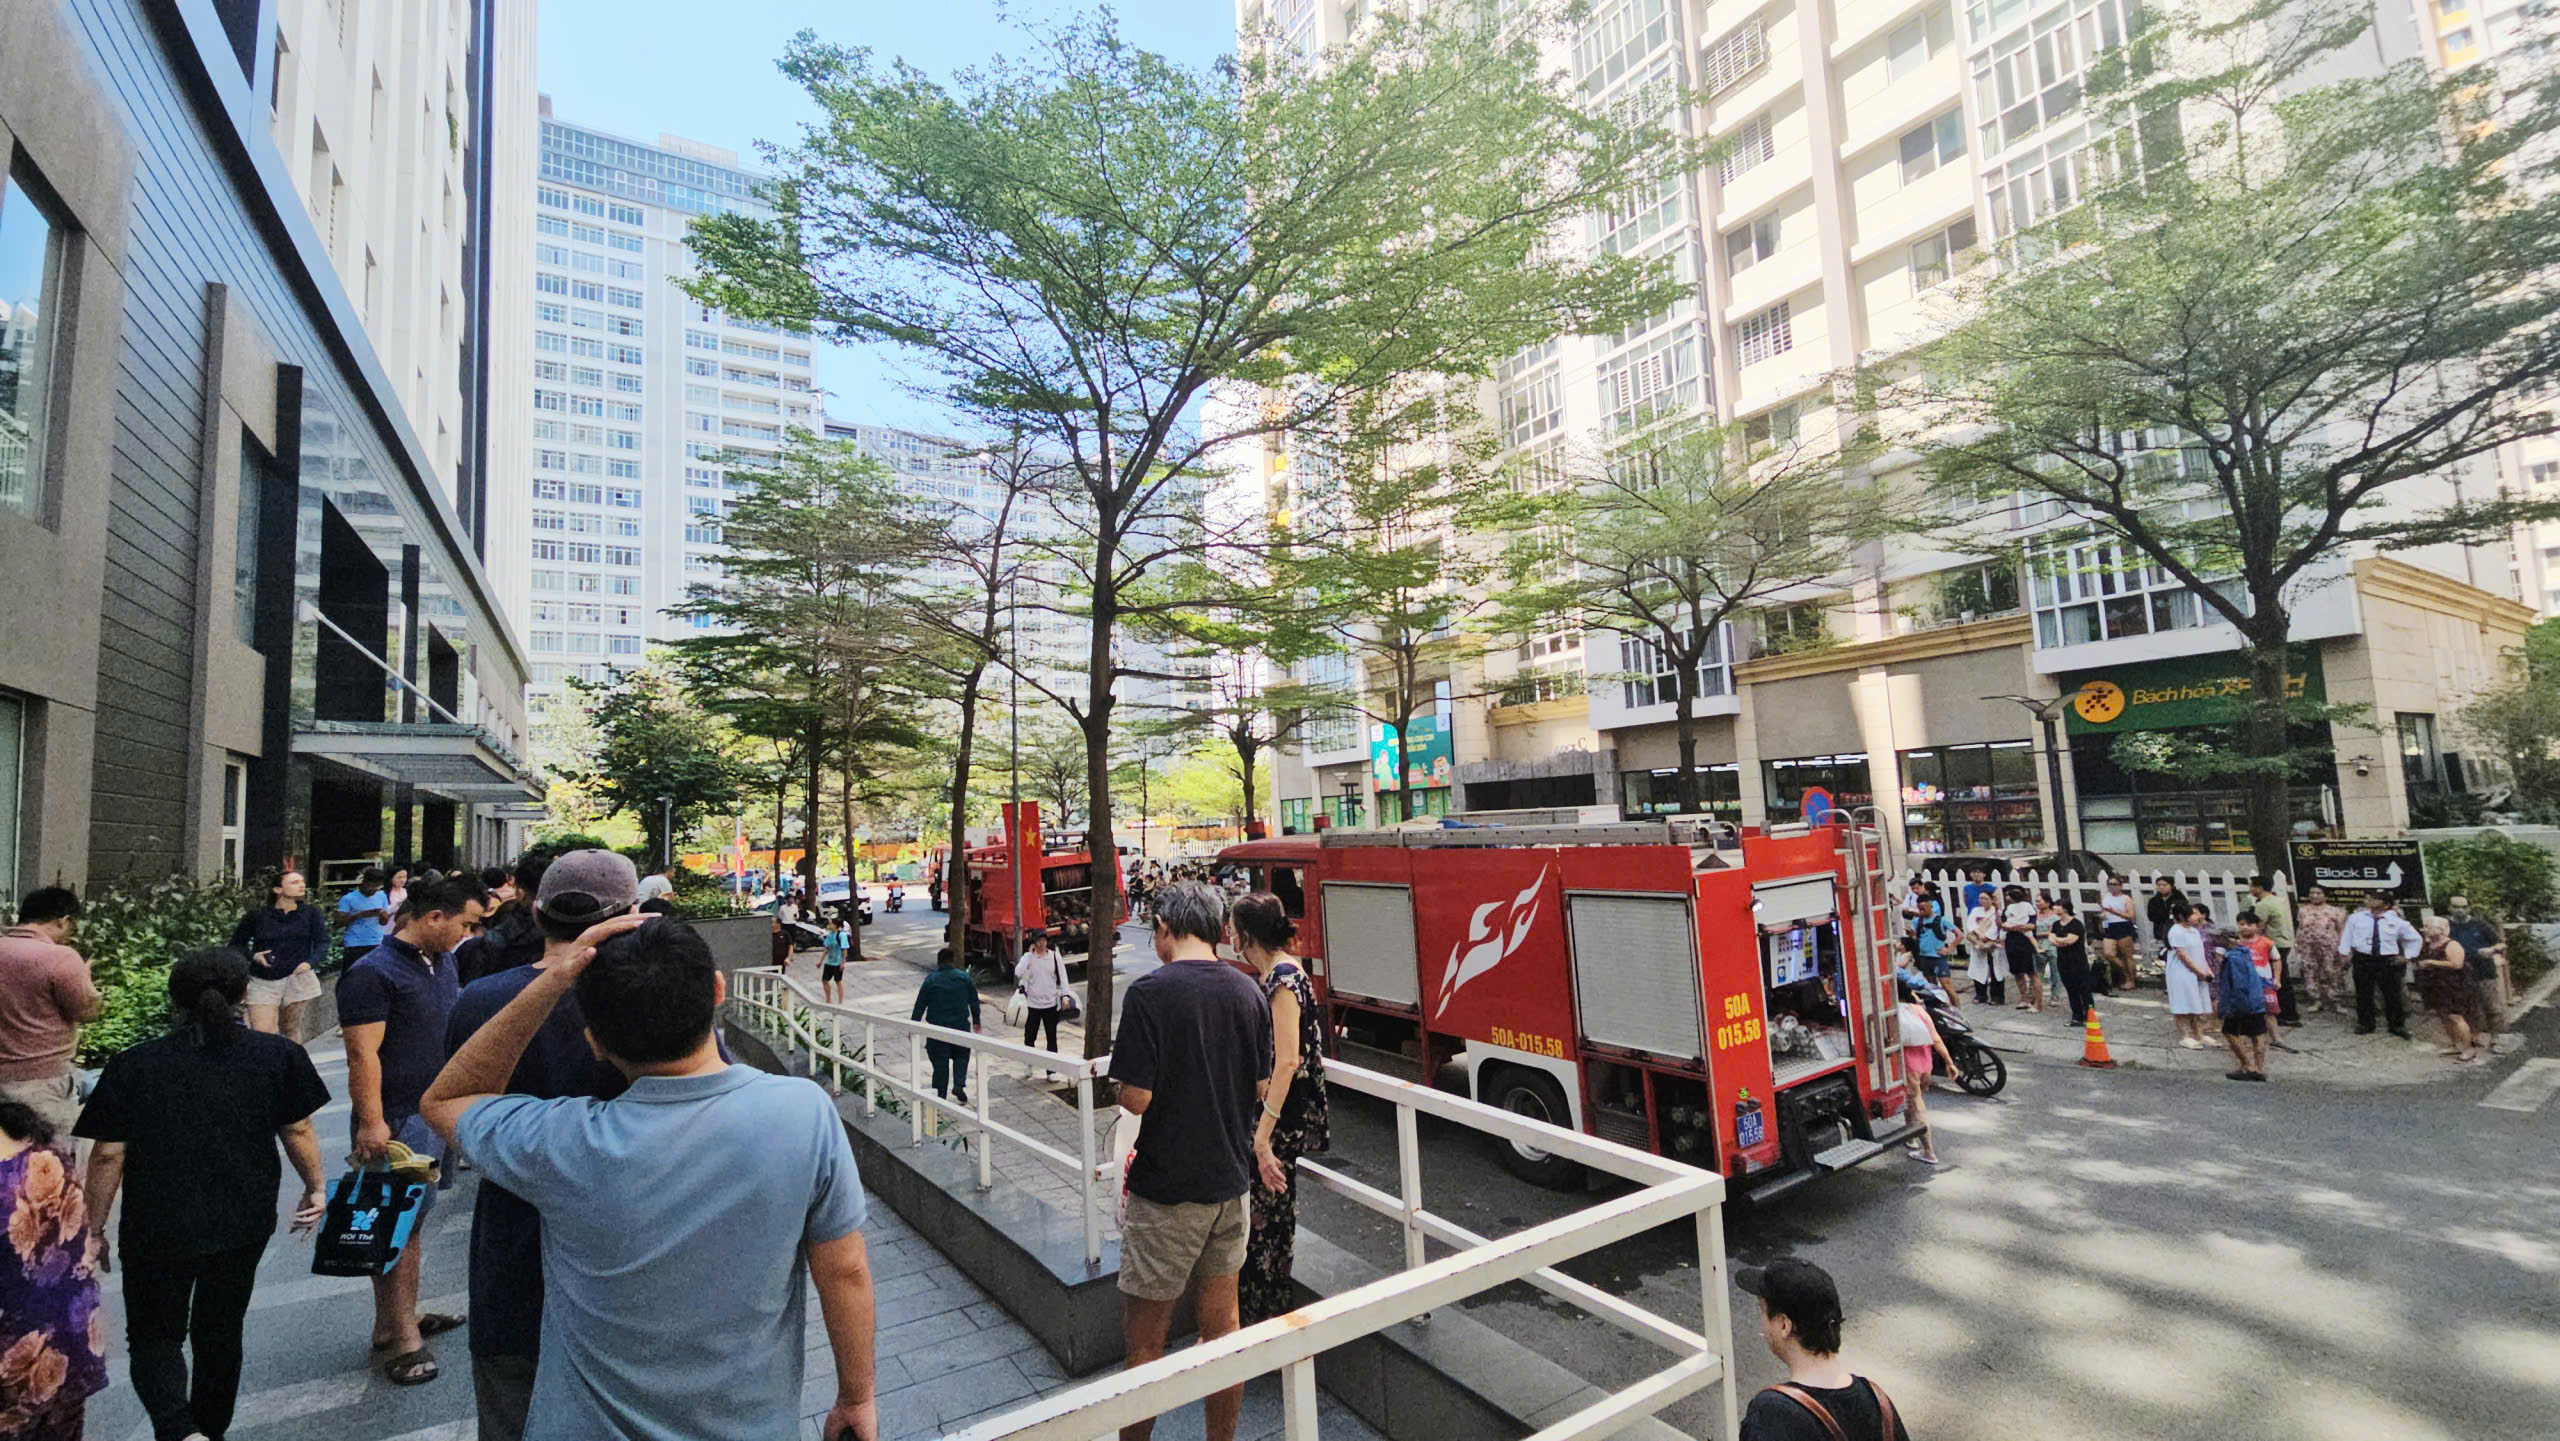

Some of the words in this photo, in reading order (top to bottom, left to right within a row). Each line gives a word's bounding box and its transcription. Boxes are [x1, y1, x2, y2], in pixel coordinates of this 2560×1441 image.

[2132, 686, 2177, 705] Bách
[2315, 867, 2360, 878] Block
[2364, 867, 2378, 878] B
[1724, 992, 1751, 1019] 50A
[1491, 1026, 1564, 1058] 50A-015.58
[1718, 1018, 1761, 1050] 015.58
[1744, 1114, 1757, 1130] 50A
